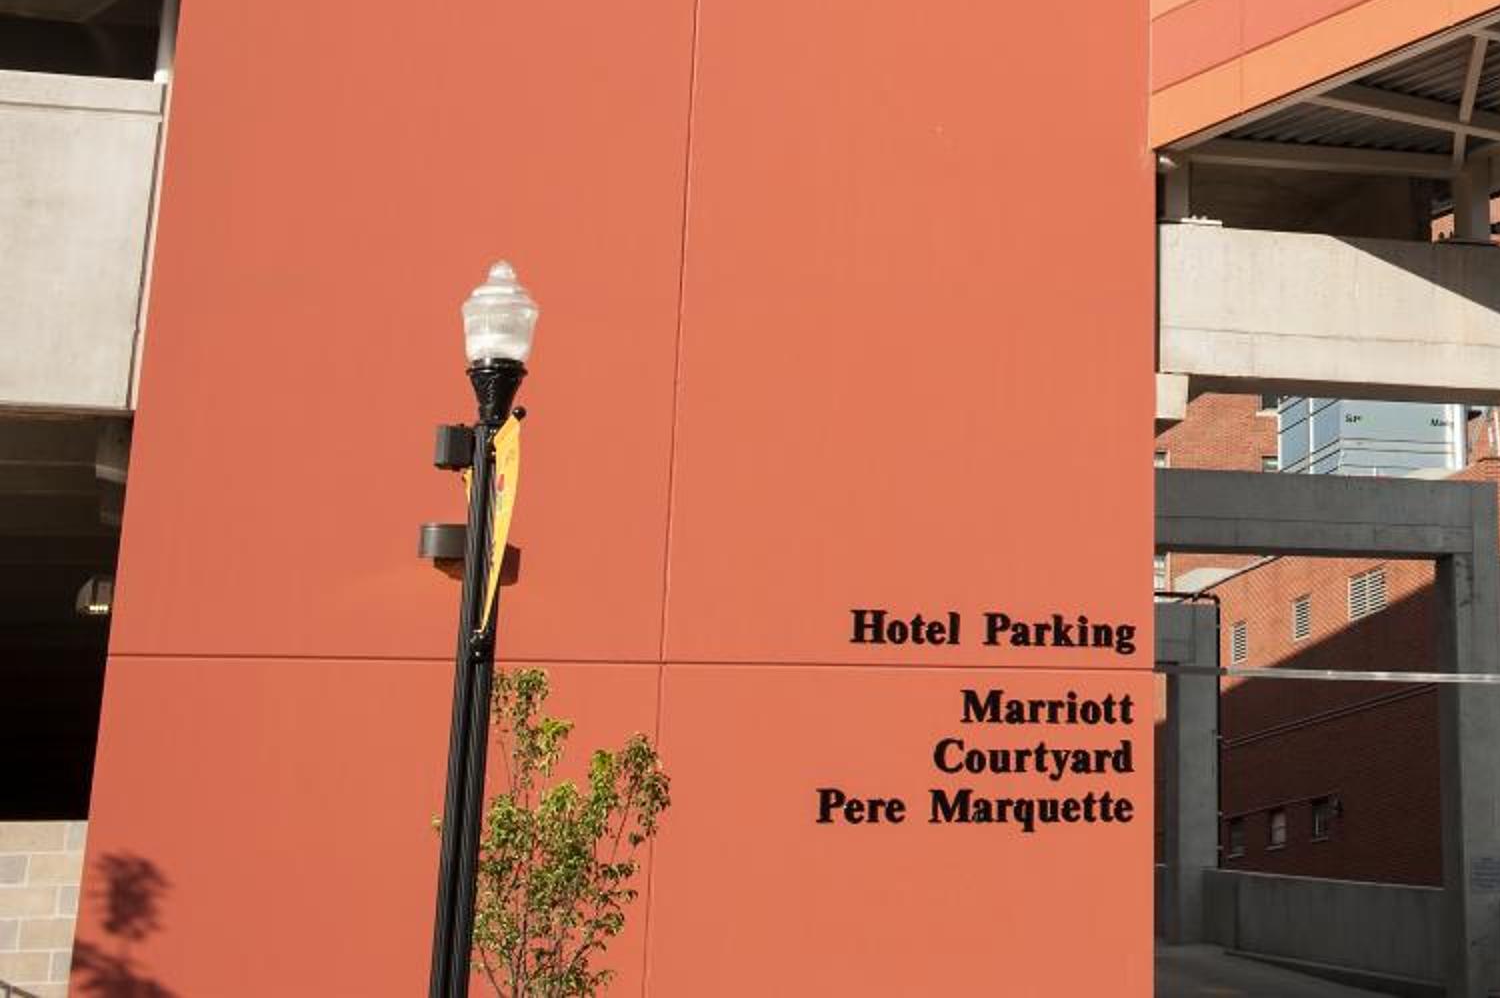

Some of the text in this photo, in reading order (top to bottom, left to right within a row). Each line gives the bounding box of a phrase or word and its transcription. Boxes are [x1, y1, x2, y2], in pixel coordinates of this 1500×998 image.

[850, 609, 1137, 654] Hotel Parking
[960, 689, 1134, 724] Marriott
[933, 738, 1135, 781] Courtyard
[815, 788, 1134, 833] Pere Marquette
